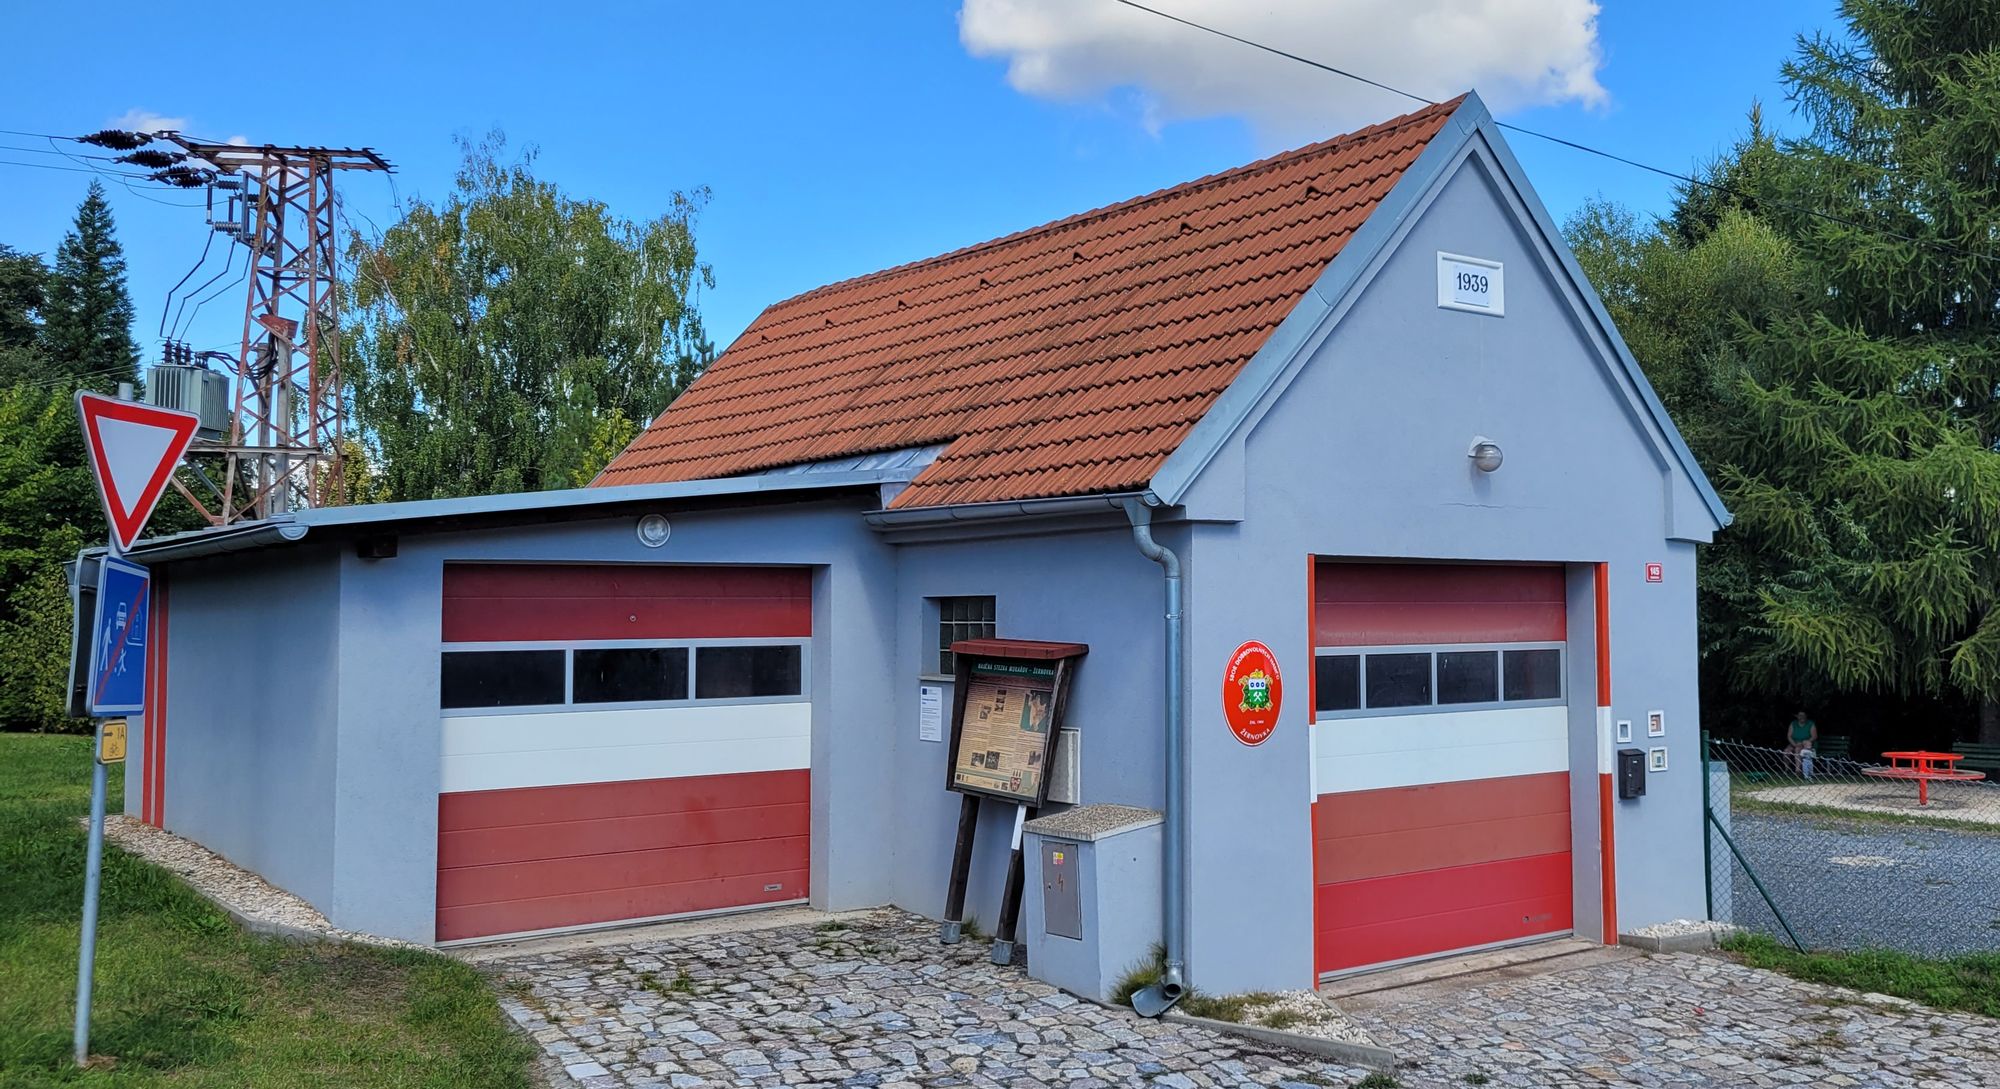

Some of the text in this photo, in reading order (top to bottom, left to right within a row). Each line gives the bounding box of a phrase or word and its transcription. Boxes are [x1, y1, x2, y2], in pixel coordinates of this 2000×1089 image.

[1456, 271, 1489, 294] 1939
[1229, 665, 1237, 682] SBOR
[1240, 728, 1270, 740] ŽERNOVKA
